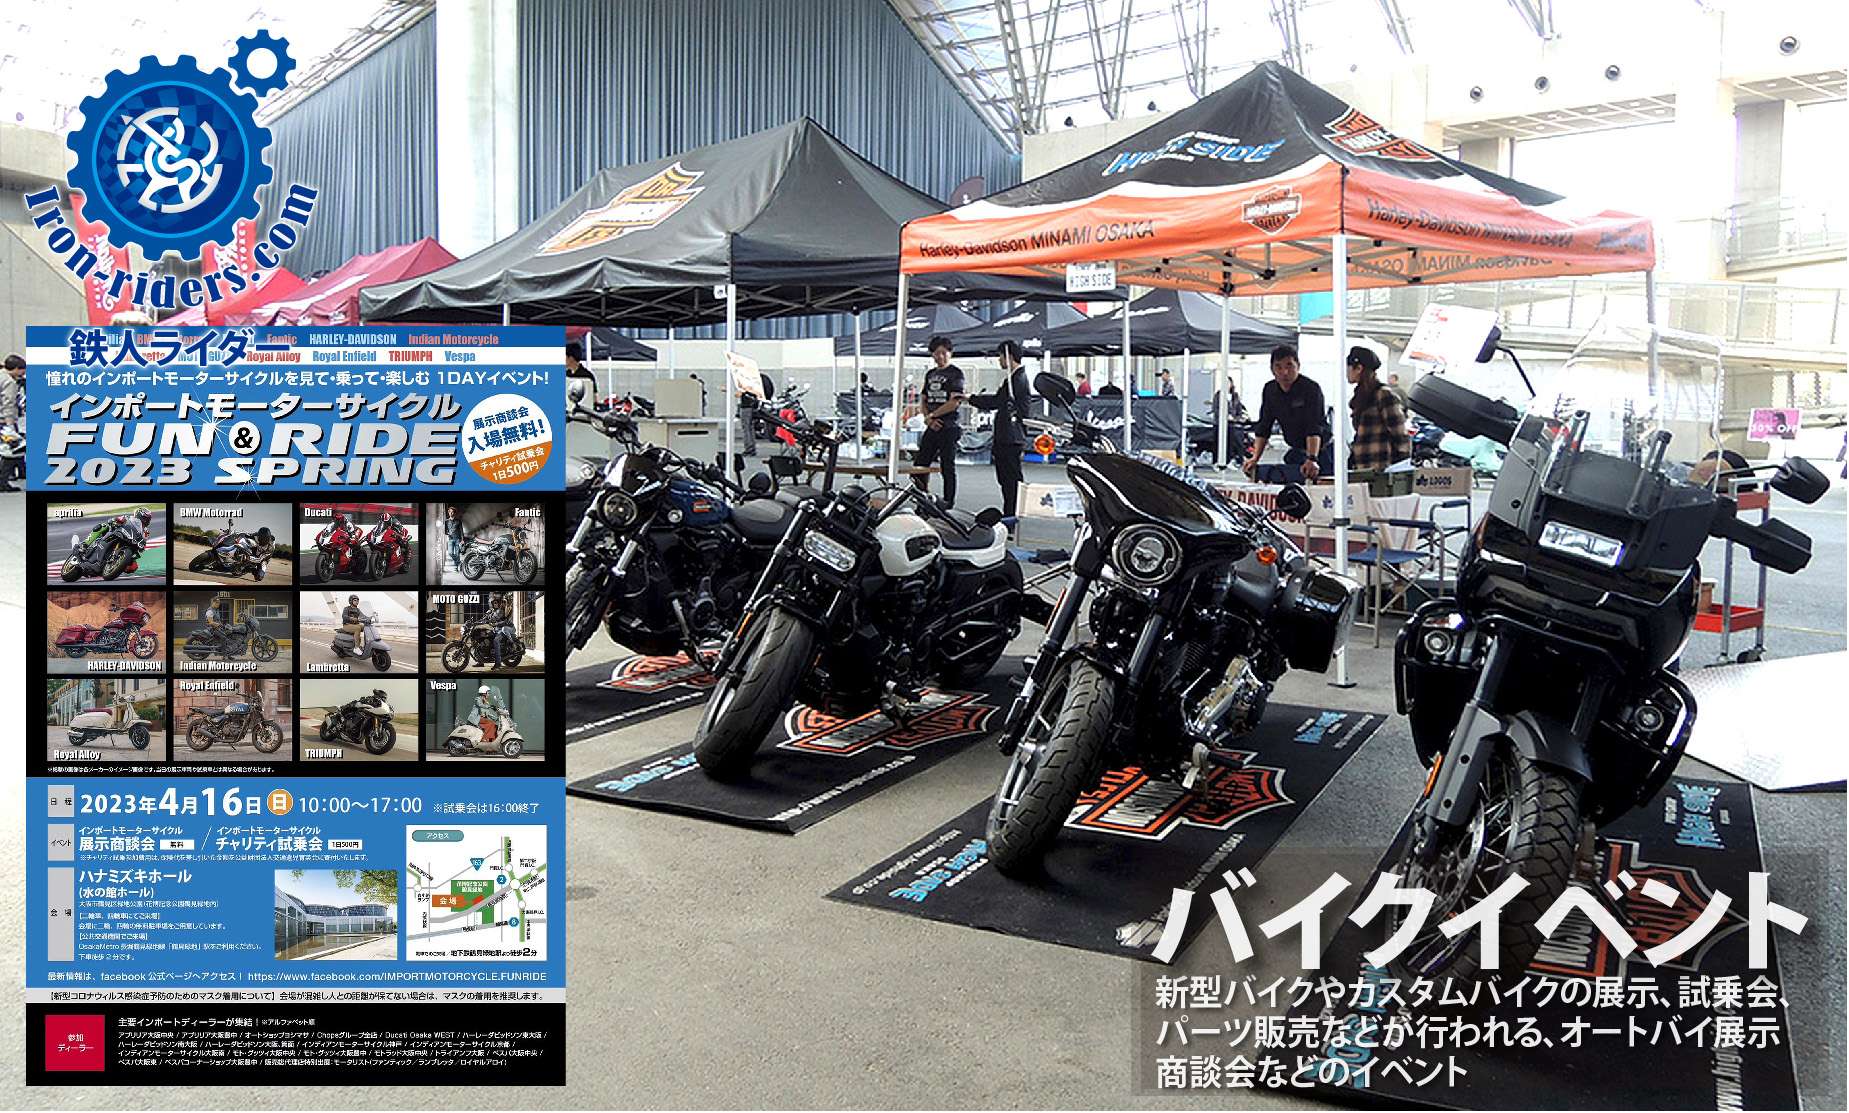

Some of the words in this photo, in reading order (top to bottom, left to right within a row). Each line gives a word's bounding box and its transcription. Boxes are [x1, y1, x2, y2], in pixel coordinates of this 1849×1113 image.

[920, 237, 1028, 259] Harley-Davidson
[1030, 225, 1091, 249] MINAMI
[1095, 220, 1155, 244] OSAKA
